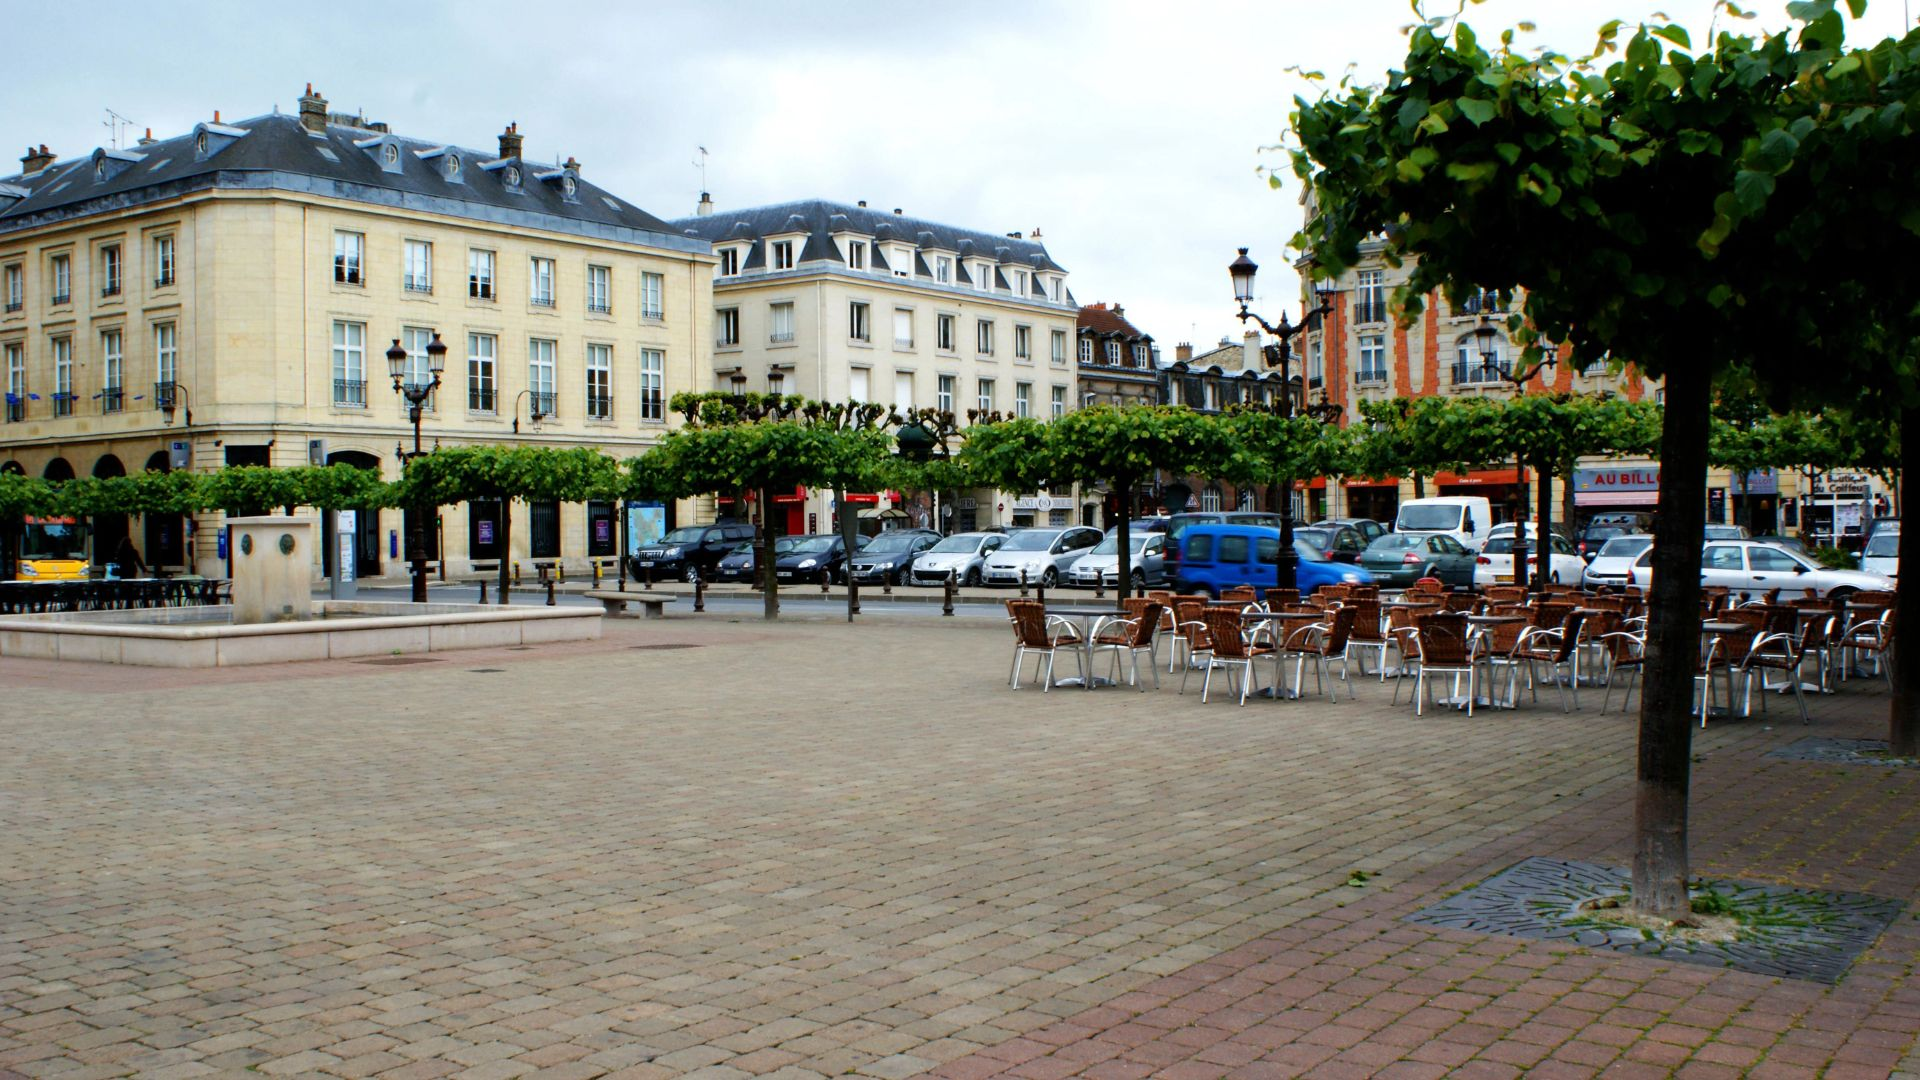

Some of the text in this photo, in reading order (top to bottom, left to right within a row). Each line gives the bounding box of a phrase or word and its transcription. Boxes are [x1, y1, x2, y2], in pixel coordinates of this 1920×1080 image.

[1595, 473, 1660, 484] AU BILL
[1829, 484, 1863, 492] Coiffeu
